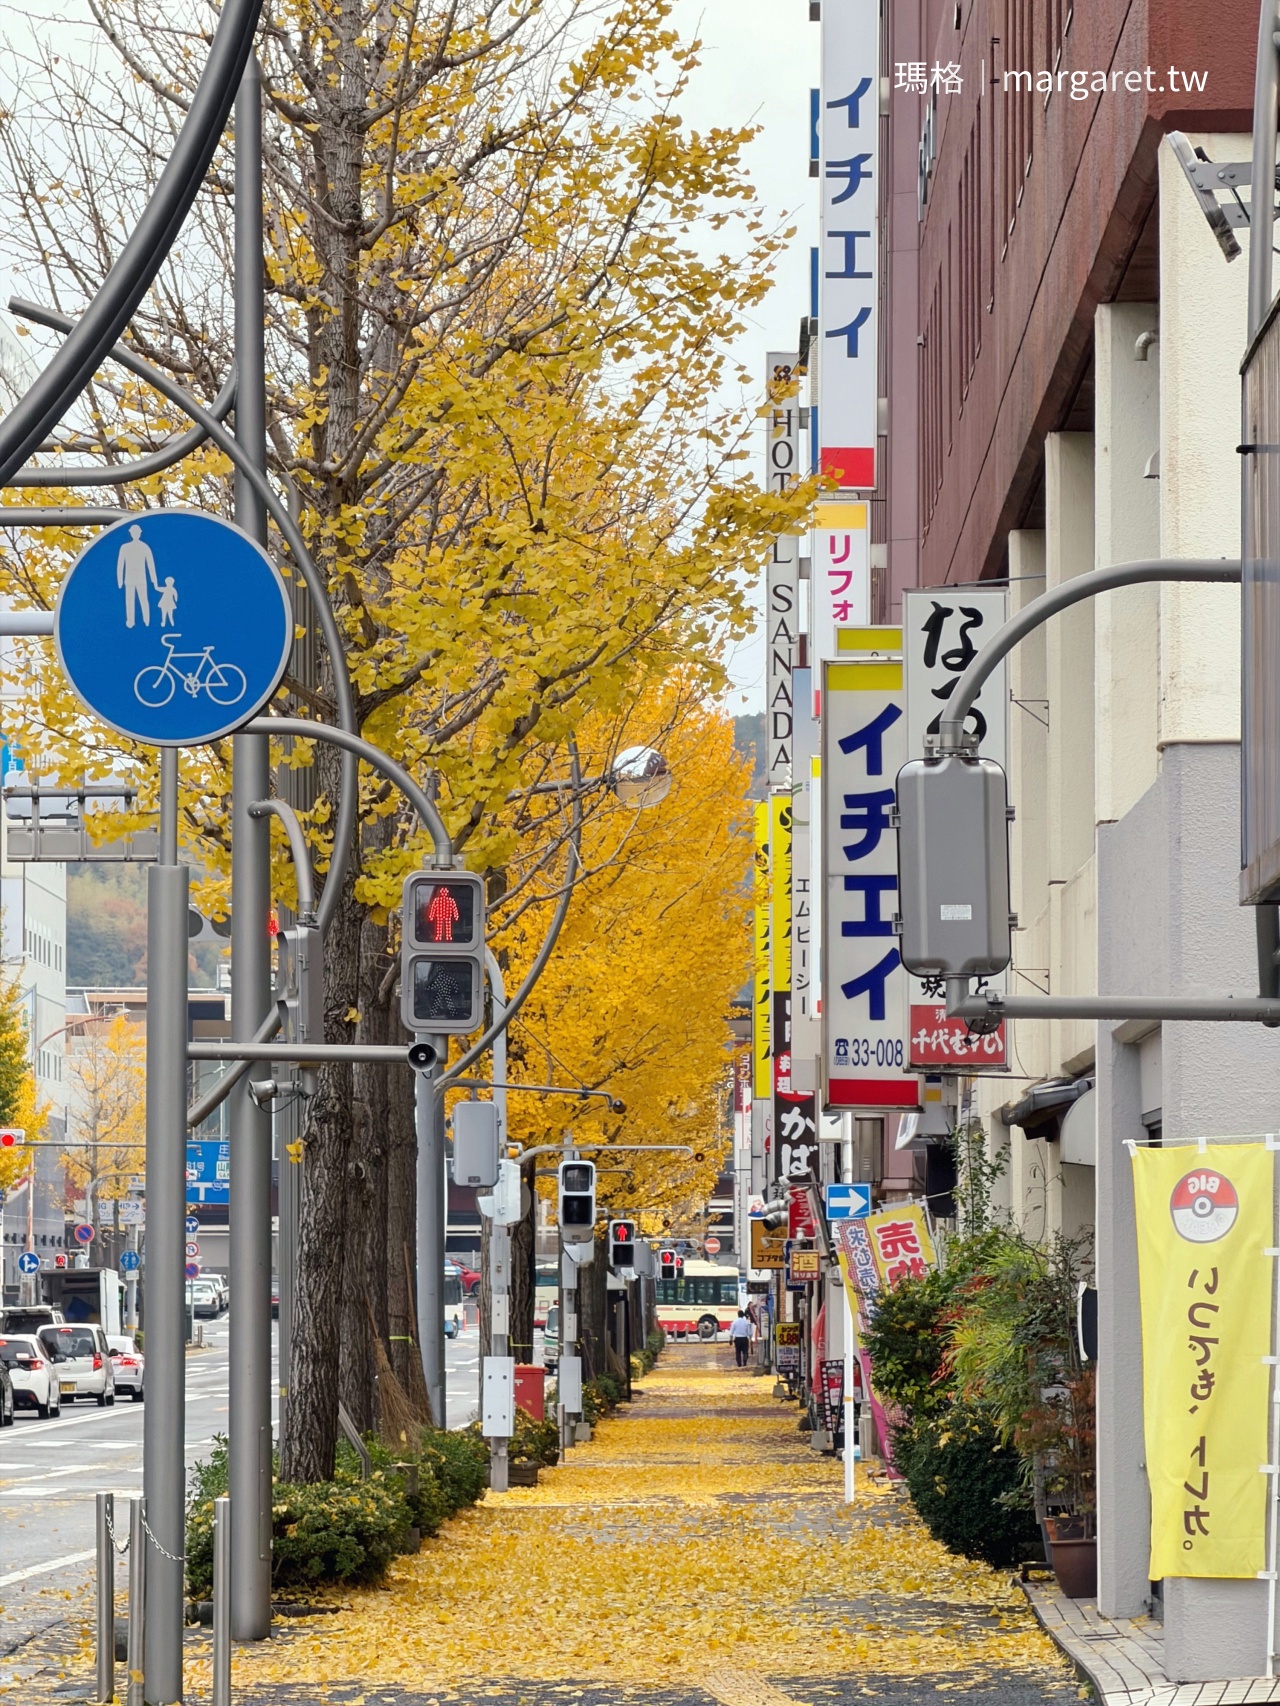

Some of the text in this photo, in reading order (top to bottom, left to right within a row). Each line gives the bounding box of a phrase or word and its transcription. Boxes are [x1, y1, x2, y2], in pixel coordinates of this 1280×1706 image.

[825, 77, 873, 359] イチエイ
[771, 584, 793, 772] SANADA
[827, 535, 854, 622] リフォ
[838, 703, 903, 1021] イチエイ
